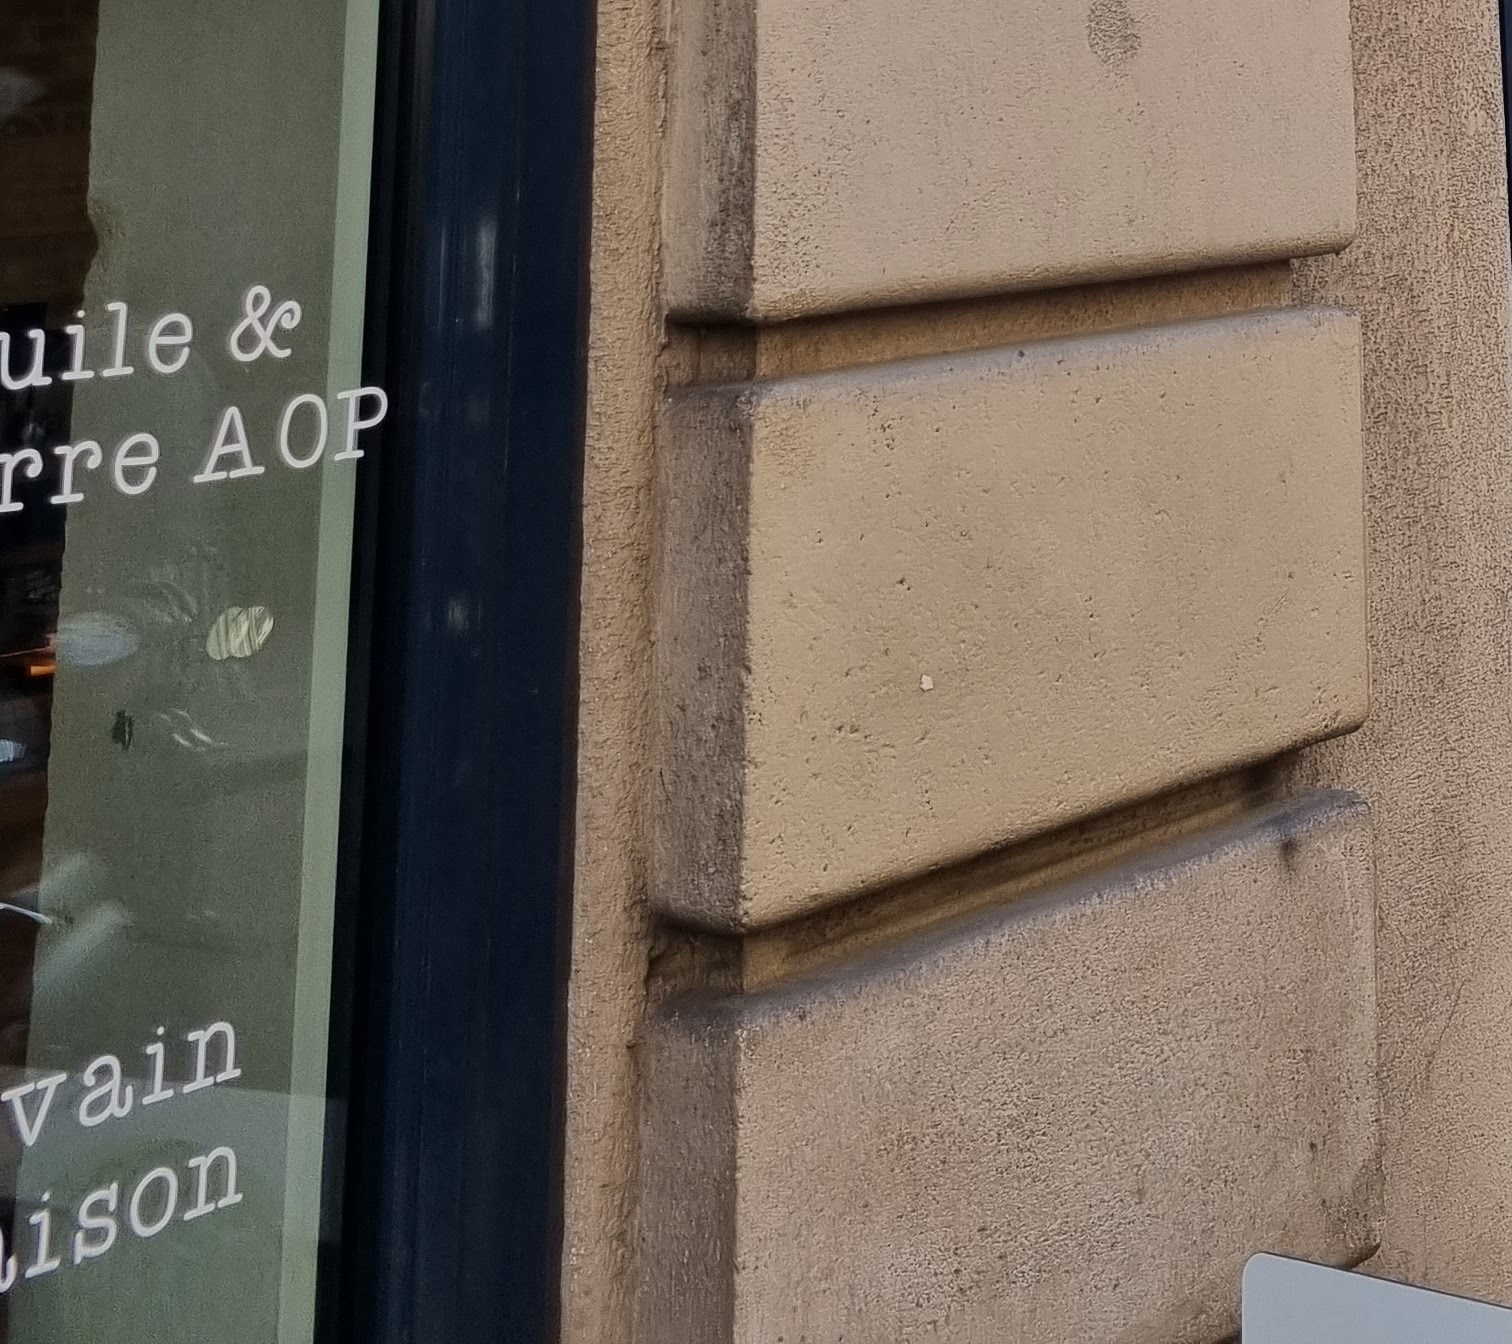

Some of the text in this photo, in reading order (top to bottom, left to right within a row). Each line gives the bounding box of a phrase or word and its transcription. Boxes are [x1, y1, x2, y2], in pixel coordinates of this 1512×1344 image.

[0, 284, 303, 391] uile &
[0, 385, 389, 513] rre AOP
[1, 1020, 243, 1147] vain
